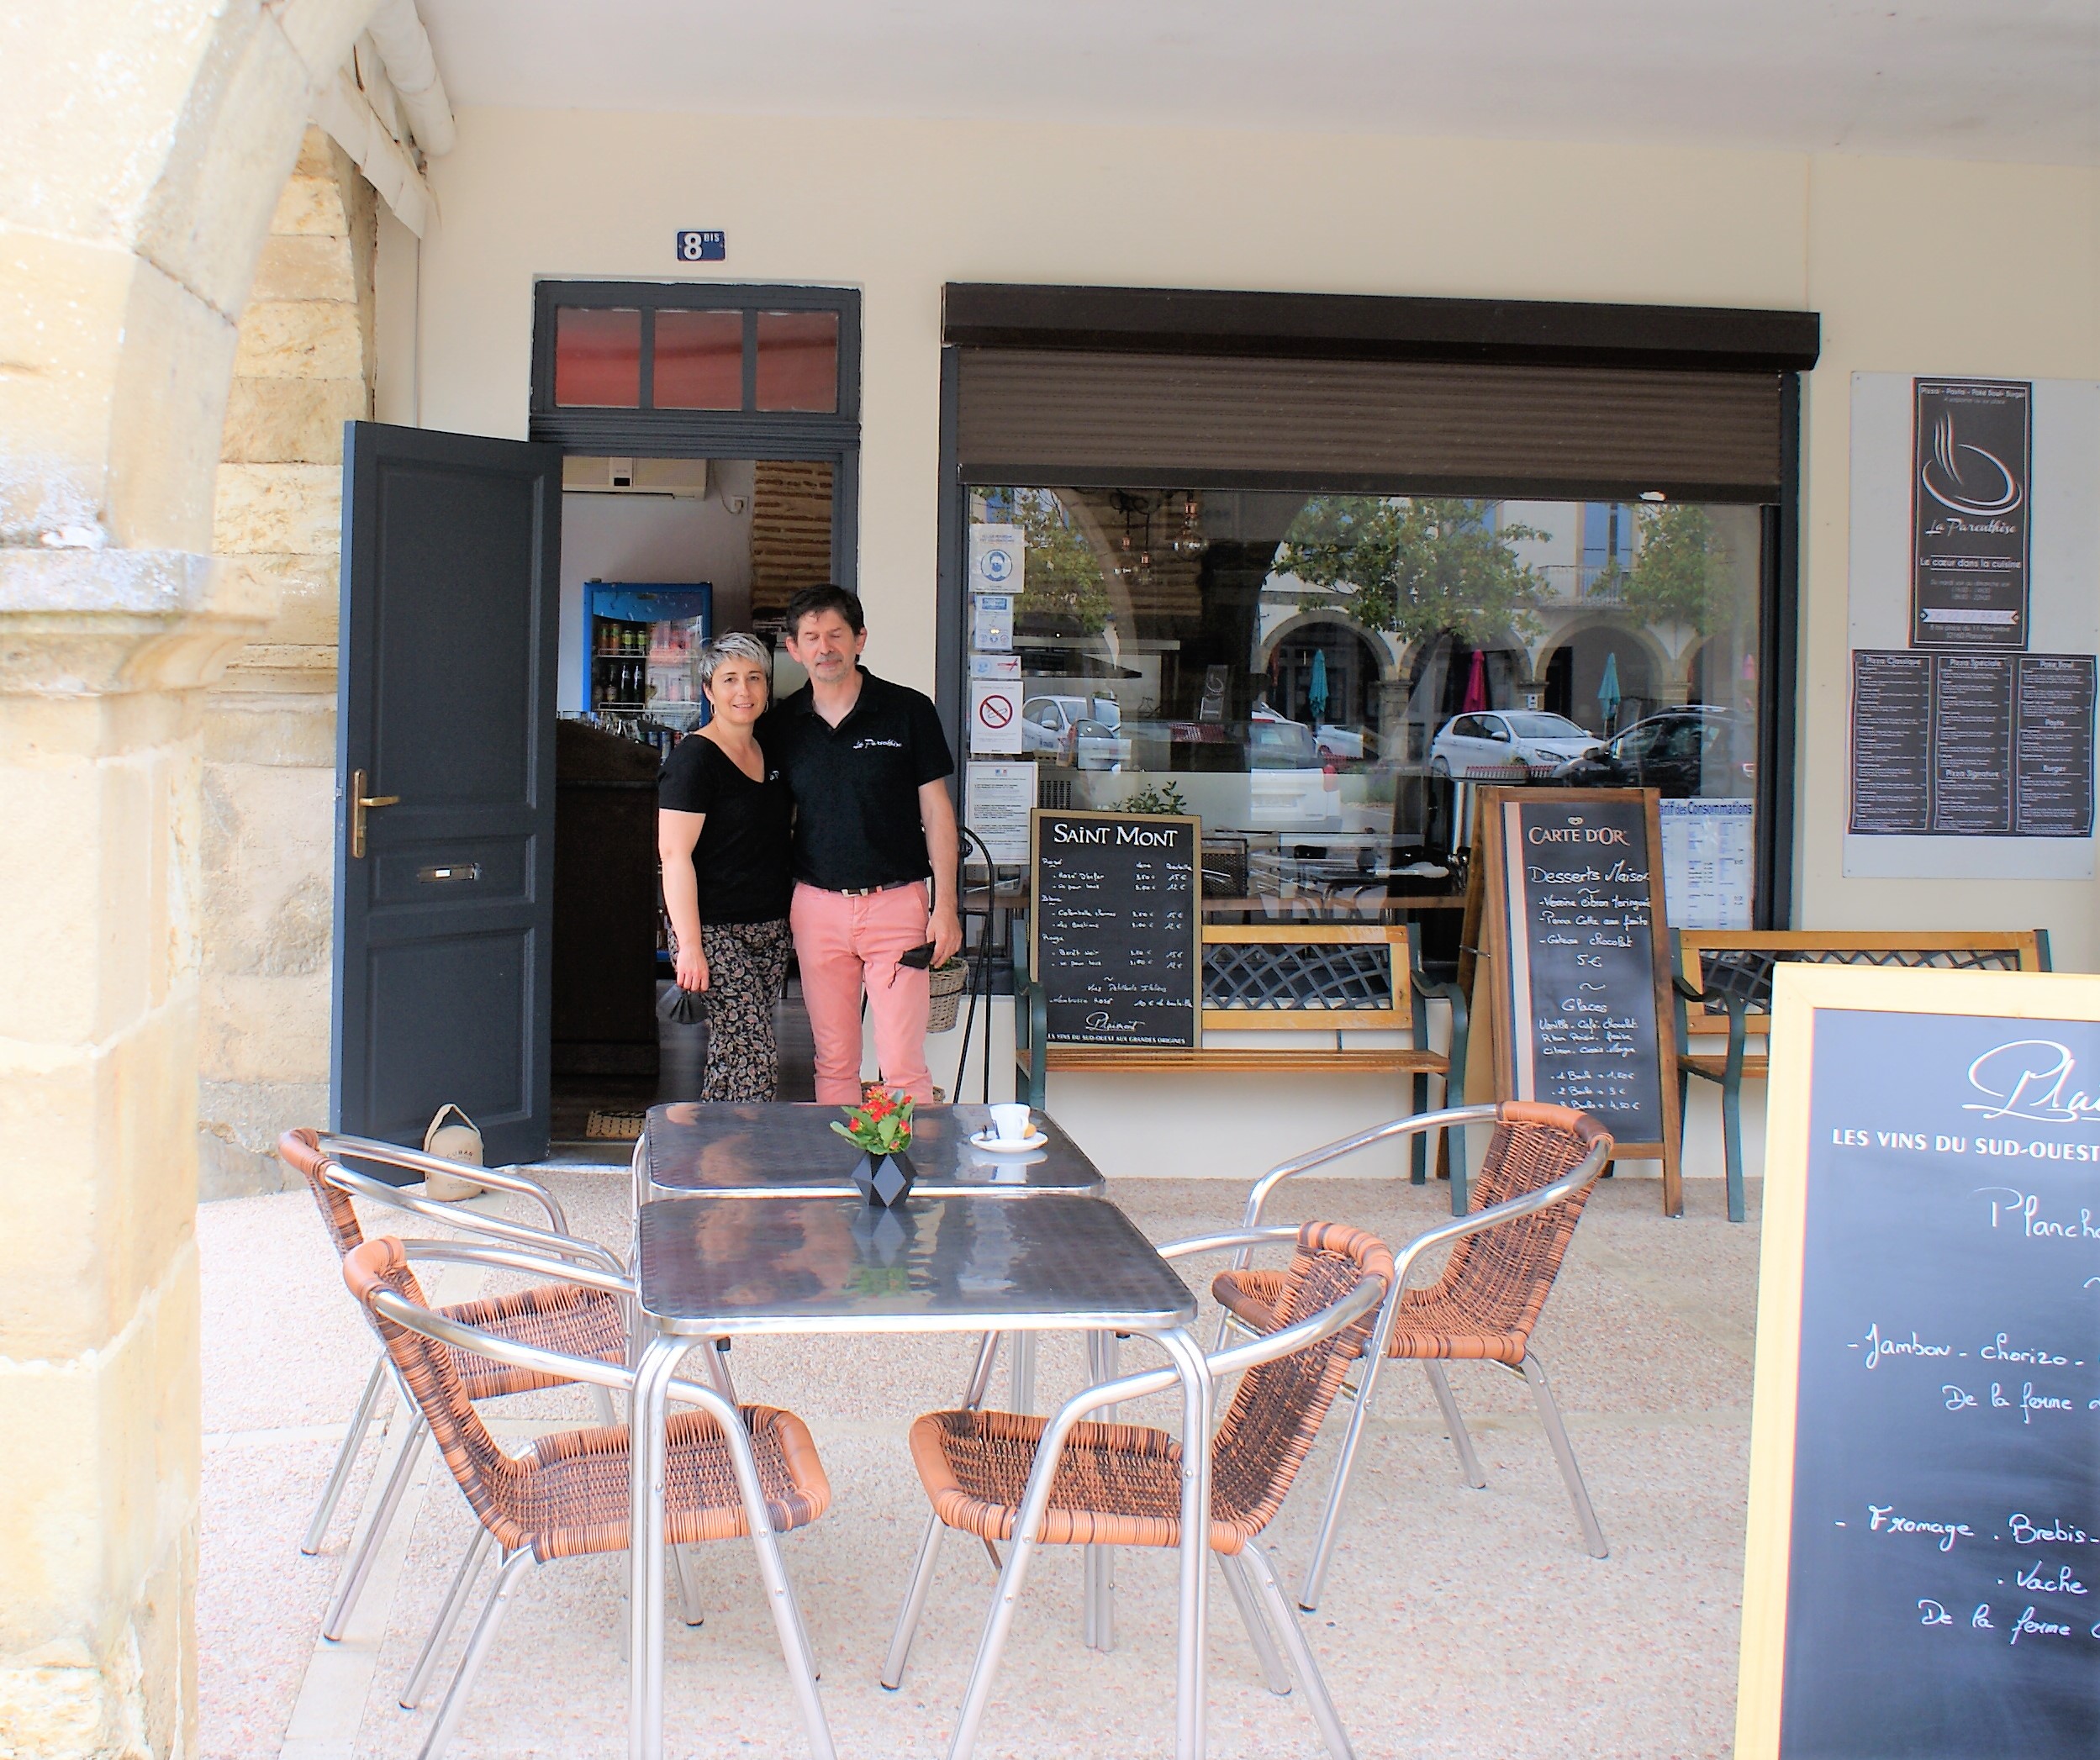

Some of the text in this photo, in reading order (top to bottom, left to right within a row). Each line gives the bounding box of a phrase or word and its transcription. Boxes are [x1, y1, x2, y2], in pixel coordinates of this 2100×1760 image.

[683, 232, 703, 261] 8
[1925, 519, 1945, 536] La
[1920, 556, 1930, 566] Le
[1957, 558, 1979, 567] dans
[1981, 559, 1990, 567] la
[1992, 560, 2021, 568] cuisine
[2043, 764, 2066, 774] Burger
[1688, 800, 1752, 814] Consommations
[1116, 825, 1179, 848] MONT
[1528, 826, 1631, 846] CARTE D'OR
[1528, 865, 1601, 883] Desserts
[1561, 997, 1607, 1014] Glaces
[1832, 1128, 2100, 1162] LES VINS DU SUD-OUEST
[1942, 1381, 2072, 1425] De la ferme
[1867, 1504, 1975, 1552] Fromage
[2017, 1559, 2088, 1594] Vache
[1918, 1599, 1953, 1626] De
[1971, 1602, 1995, 1628] la
[2010, 1605, 2071, 1646] ferme
